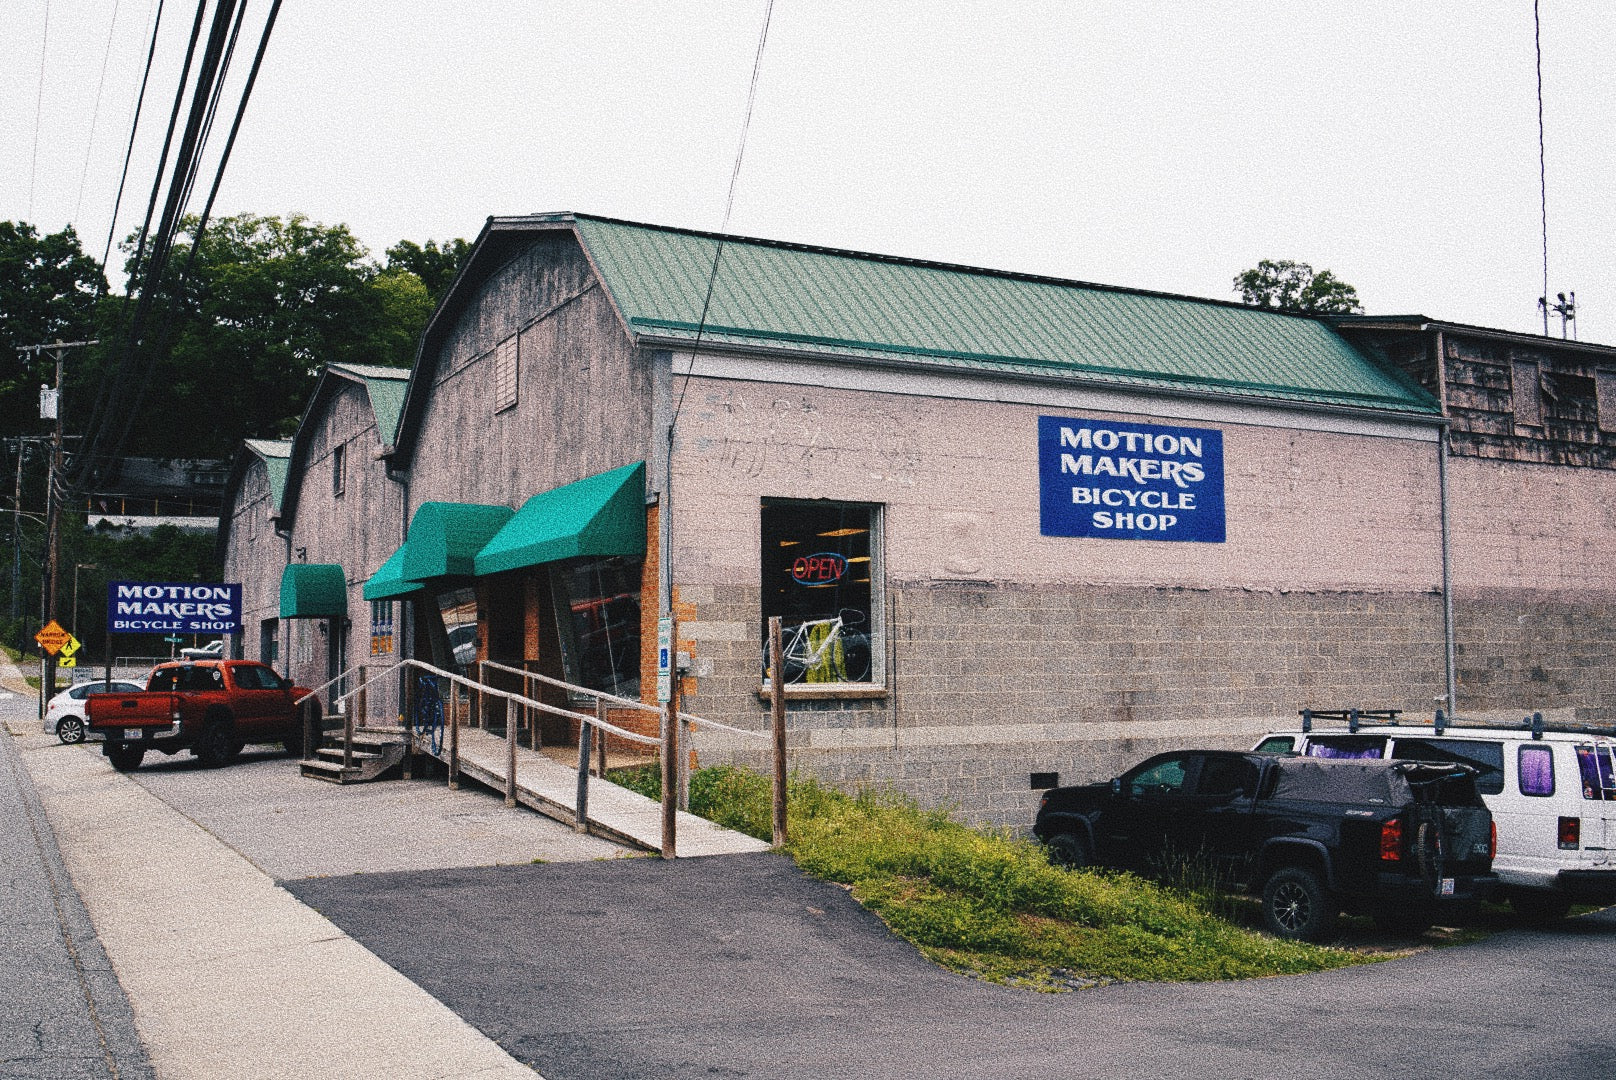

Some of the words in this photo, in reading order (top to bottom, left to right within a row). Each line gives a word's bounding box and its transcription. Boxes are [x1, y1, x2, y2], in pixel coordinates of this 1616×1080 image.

[1060, 427, 1202, 457] MOTION
[1061, 454, 1205, 488] MAKERS
[1072, 487, 1197, 509] BICYCLE
[1092, 511, 1177, 531] SHOP
[793, 557, 843, 579] OPEN
[118, 585, 231, 600] MOTION
[117, 602, 232, 620] MAKERS
[114, 620, 182, 629] BICYCLE
[190, 621, 235, 630] SHOP
